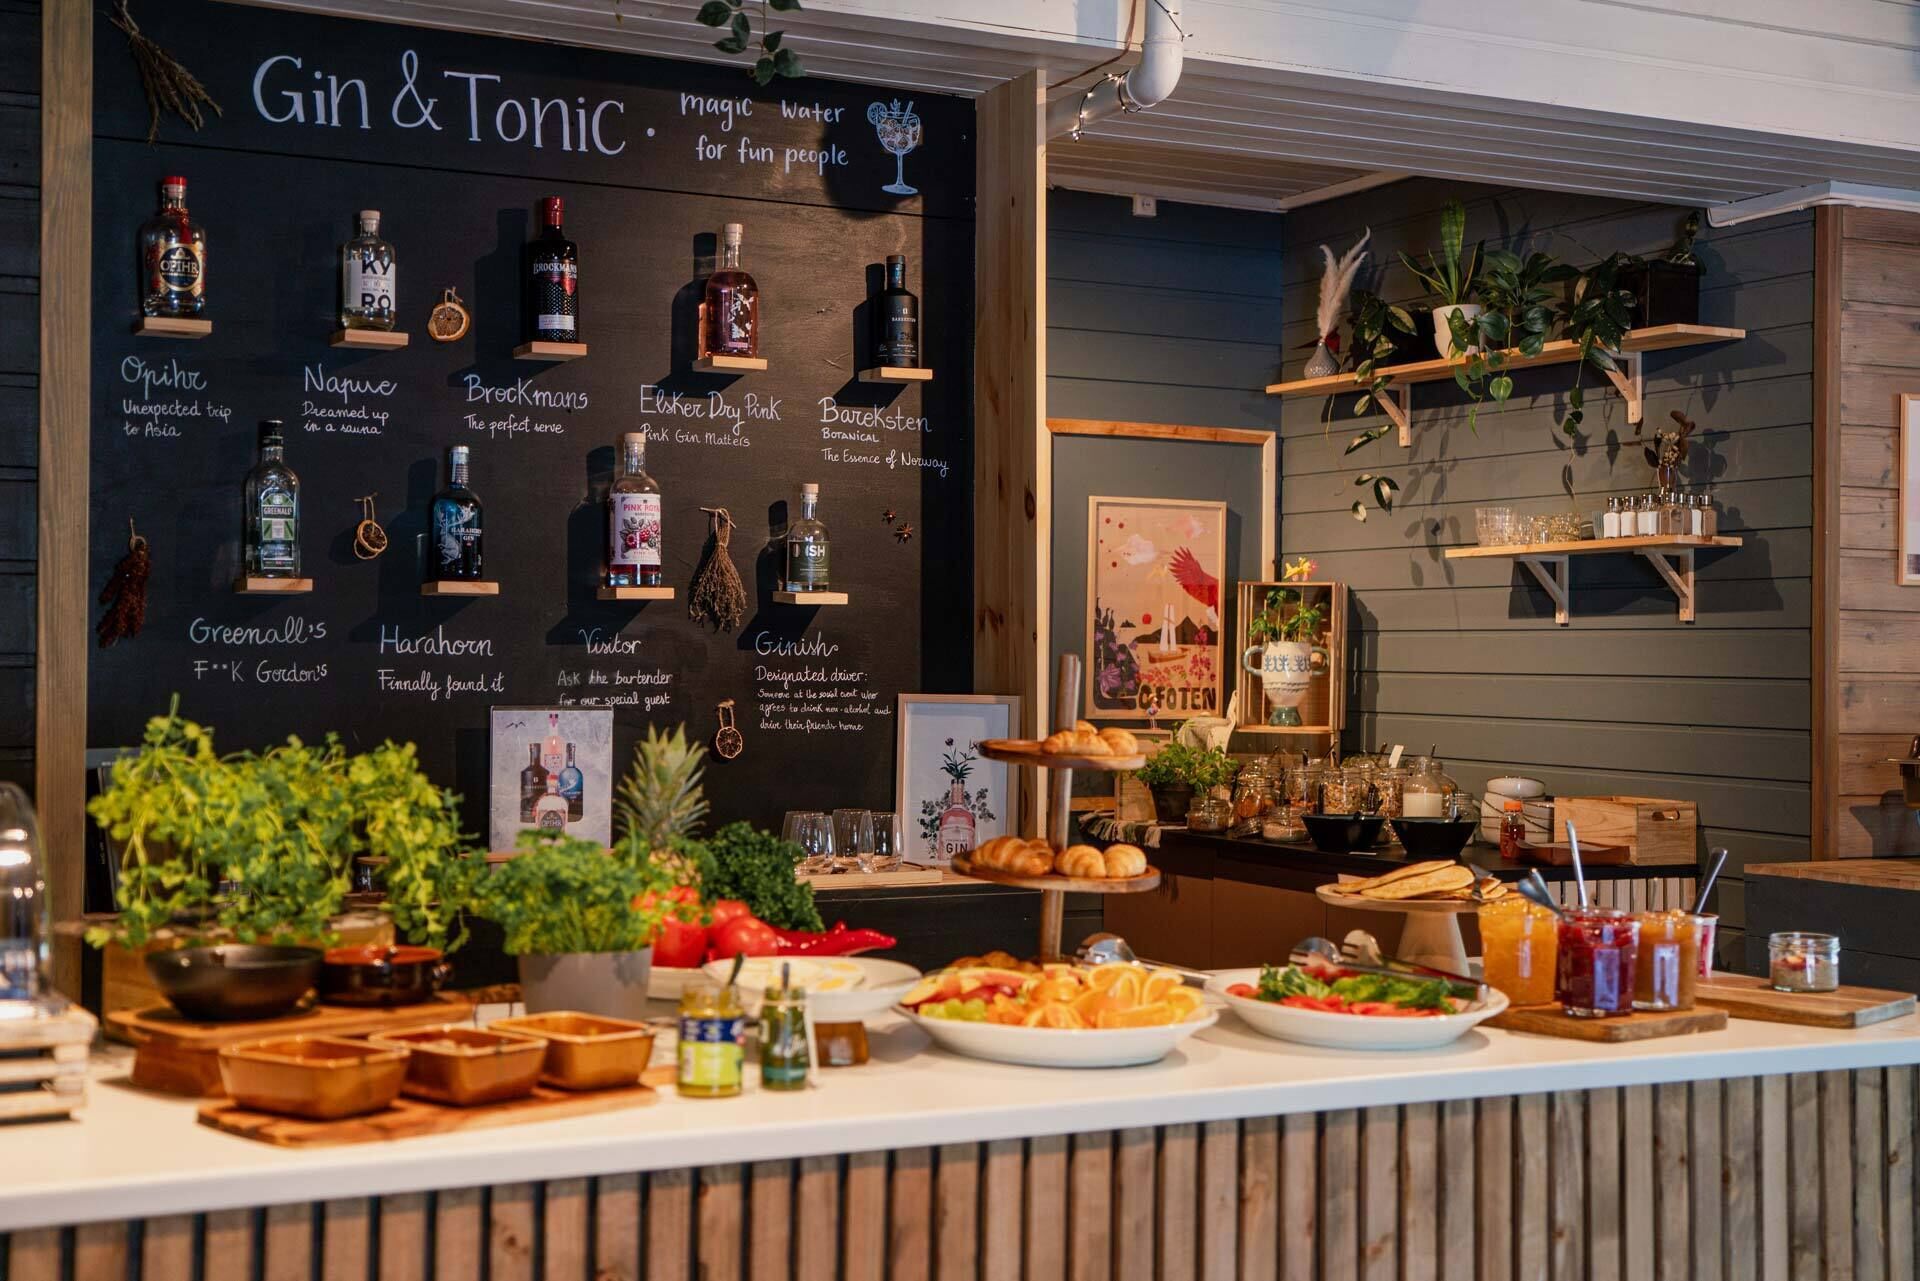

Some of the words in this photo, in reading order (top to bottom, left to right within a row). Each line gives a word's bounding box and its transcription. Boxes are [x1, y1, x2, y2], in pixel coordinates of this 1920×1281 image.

[253, 55, 371, 129] Gin
[391, 49, 443, 131] &
[443, 70, 626, 156] Tonic
[680, 92, 753, 132] magic
[695, 135, 728, 161] for
[737, 136, 775, 164] fun
[785, 144, 849, 176] people
[160, 260, 199, 274] OPIHR
[121, 355, 207, 400] Opihr
[304, 363, 398, 404] Napue
[123, 399, 201, 424] Unexpected
[206, 400, 232, 423] trip
[301, 401, 367, 419] Dreamed
[372, 410, 390, 426] up
[707, 391, 746, 436] Dry
[123, 422, 140, 437] to
[145, 421, 182, 438] Asia
[304, 422, 321, 432] in
[325, 423, 336, 432] a
[340, 424, 382, 435] sauna
[464, 413, 485, 431] The
[489, 414, 529, 439] perfect
[533, 420, 565, 434] serve
[675, 429, 701, 444] Gin
[705, 431, 751, 448] Matters
[821, 447, 840, 462] The
[843, 449, 881, 464] Essence
[886, 448, 897, 470] of
[901, 451, 950, 478] Norway
[189, 615, 328, 645] Greenall's
[380, 624, 494, 657] Harahorn
[579, 628, 642, 654] Visitor
[755, 631, 839, 657] Ginish
[256, 659, 328, 683] Gordon's
[588, 669, 609, 685] the
[615, 669, 673, 685] bartender
[755, 665, 828, 690] Designated
[830, 667, 868, 682] driver:
[377, 668, 441, 700] Finnally
[445, 671, 488, 699] found
[491, 671, 505, 693] it
[757, 688, 791, 699] Someone
[794, 689, 803, 698] at
[806, 689, 817, 699] the
[819, 688, 838, 699] social
[840, 689, 858, 697] event
[861, 691, 879, 700] who
[558, 692, 576, 706] for
[580, 696, 600, 706] our
[606, 691, 639, 707] special
[645, 692, 671, 712] guest
[759, 703, 786, 717] agrees
[789, 703, 798, 712] to
[874, 704, 891, 715] and
[759, 718, 782, 730] drive
[784, 719, 805, 730] their
[804, 720, 836, 734] friends
[946, 842, 968, 854] GIN
